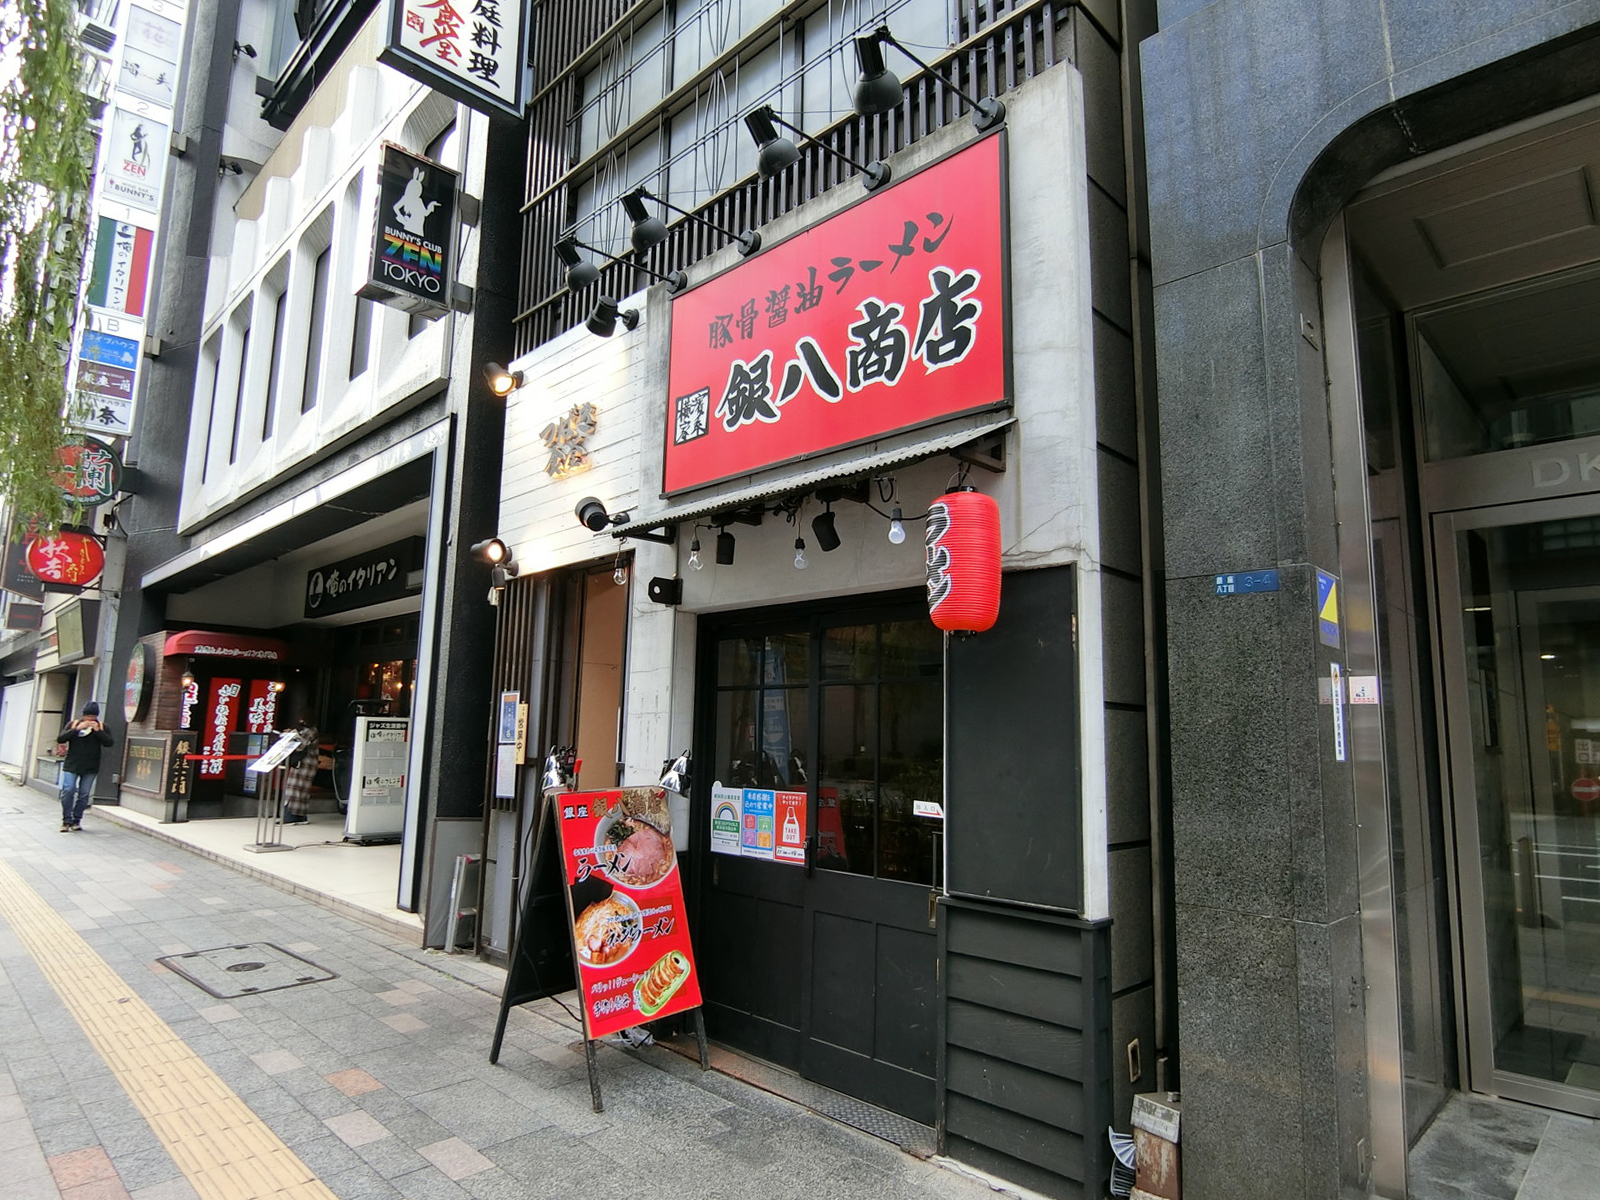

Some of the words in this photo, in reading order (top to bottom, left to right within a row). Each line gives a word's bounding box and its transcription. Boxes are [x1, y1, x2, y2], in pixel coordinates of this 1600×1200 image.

[137, 101, 150, 113] 2
[123, 161, 146, 177] ZEN
[114, 184, 154, 201] BUNNY'S
[385, 225, 421, 246] BUNNY'S
[422, 240, 443, 253] CLUB
[381, 259, 440, 293] TOKYO
[709, 212, 954, 349] 豚骨醤油ラーメン
[107, 318, 120, 332] B
[714, 265, 982, 434] 銀八商店
[326, 558, 398, 598] 俺のイタリアン
[1216, 585, 1235, 593] 八丁目
[171, 740, 193, 794] 銀座一蘭
[564, 805, 589, 819] 銀座
[577, 852, 632, 882] ラーメン
